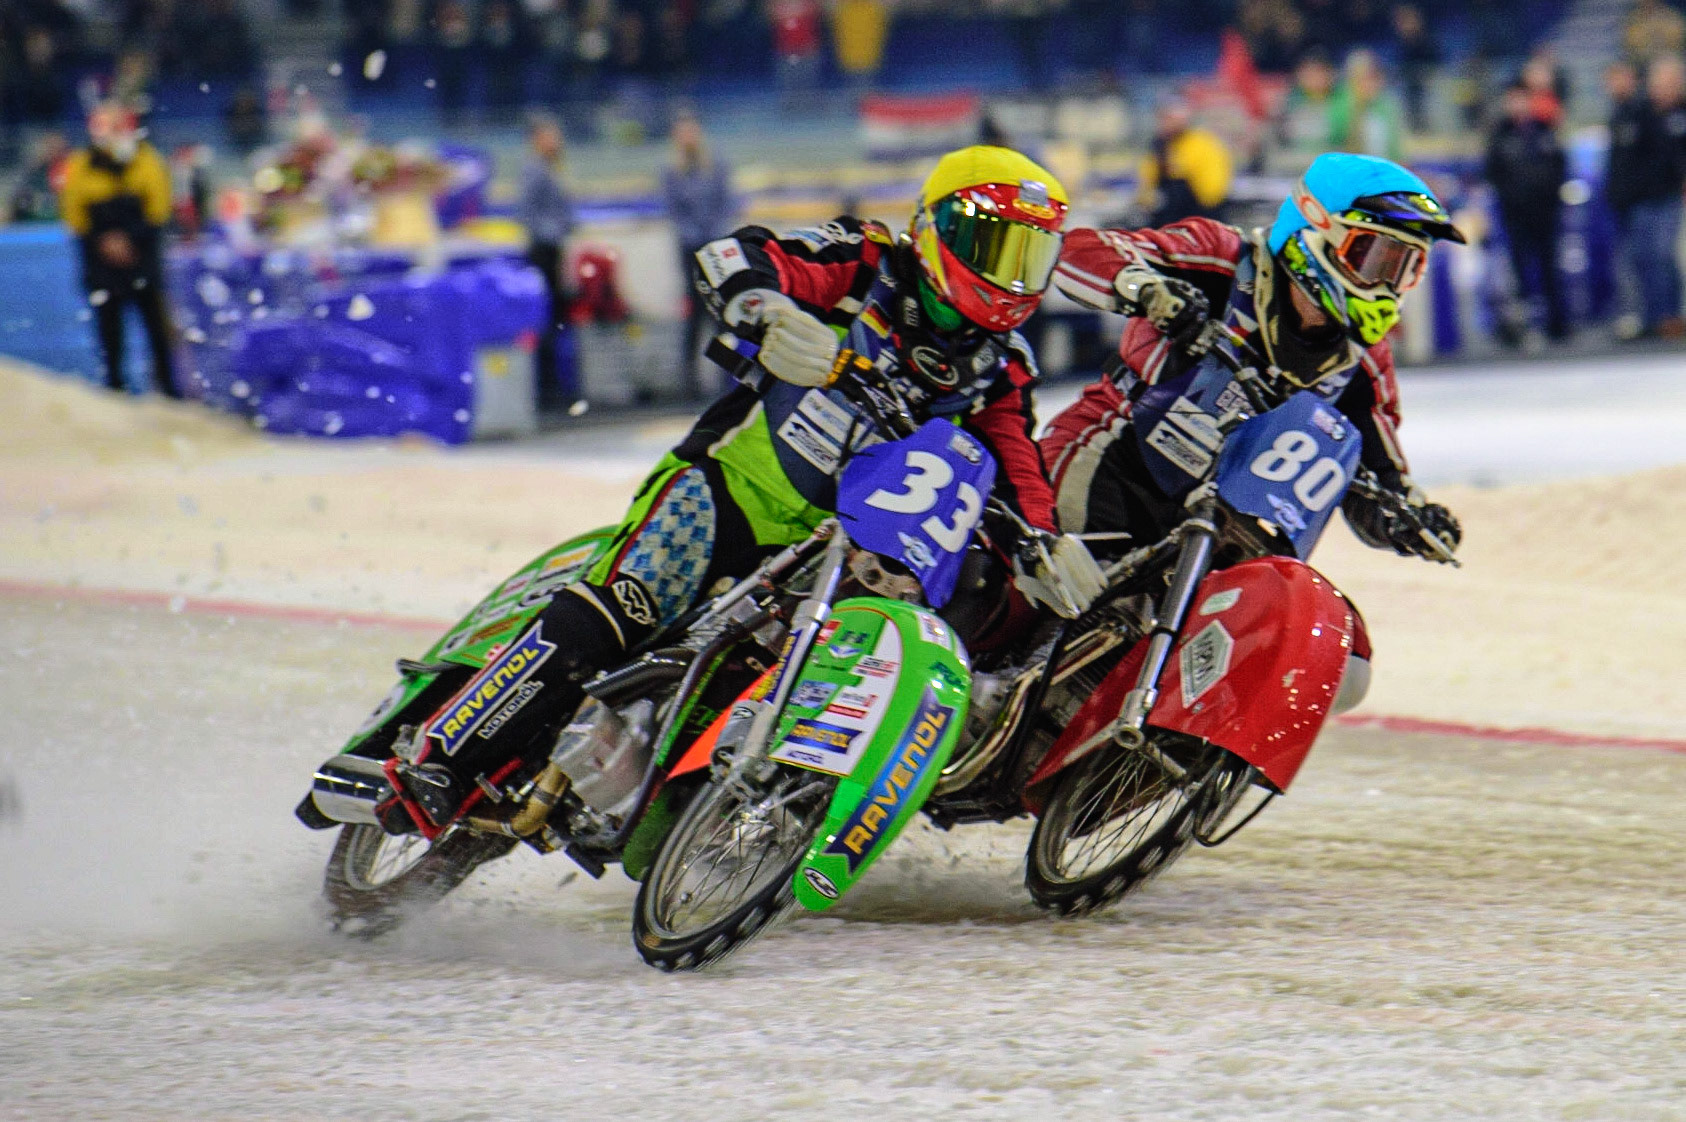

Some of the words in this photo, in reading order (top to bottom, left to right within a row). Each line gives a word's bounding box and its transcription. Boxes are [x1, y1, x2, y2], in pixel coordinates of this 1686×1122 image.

[864, 450, 983, 553] 33
[1251, 430, 1346, 512] 80
[442, 647, 540, 739] RAVENOL
[843, 711, 947, 855] RAVENOL
